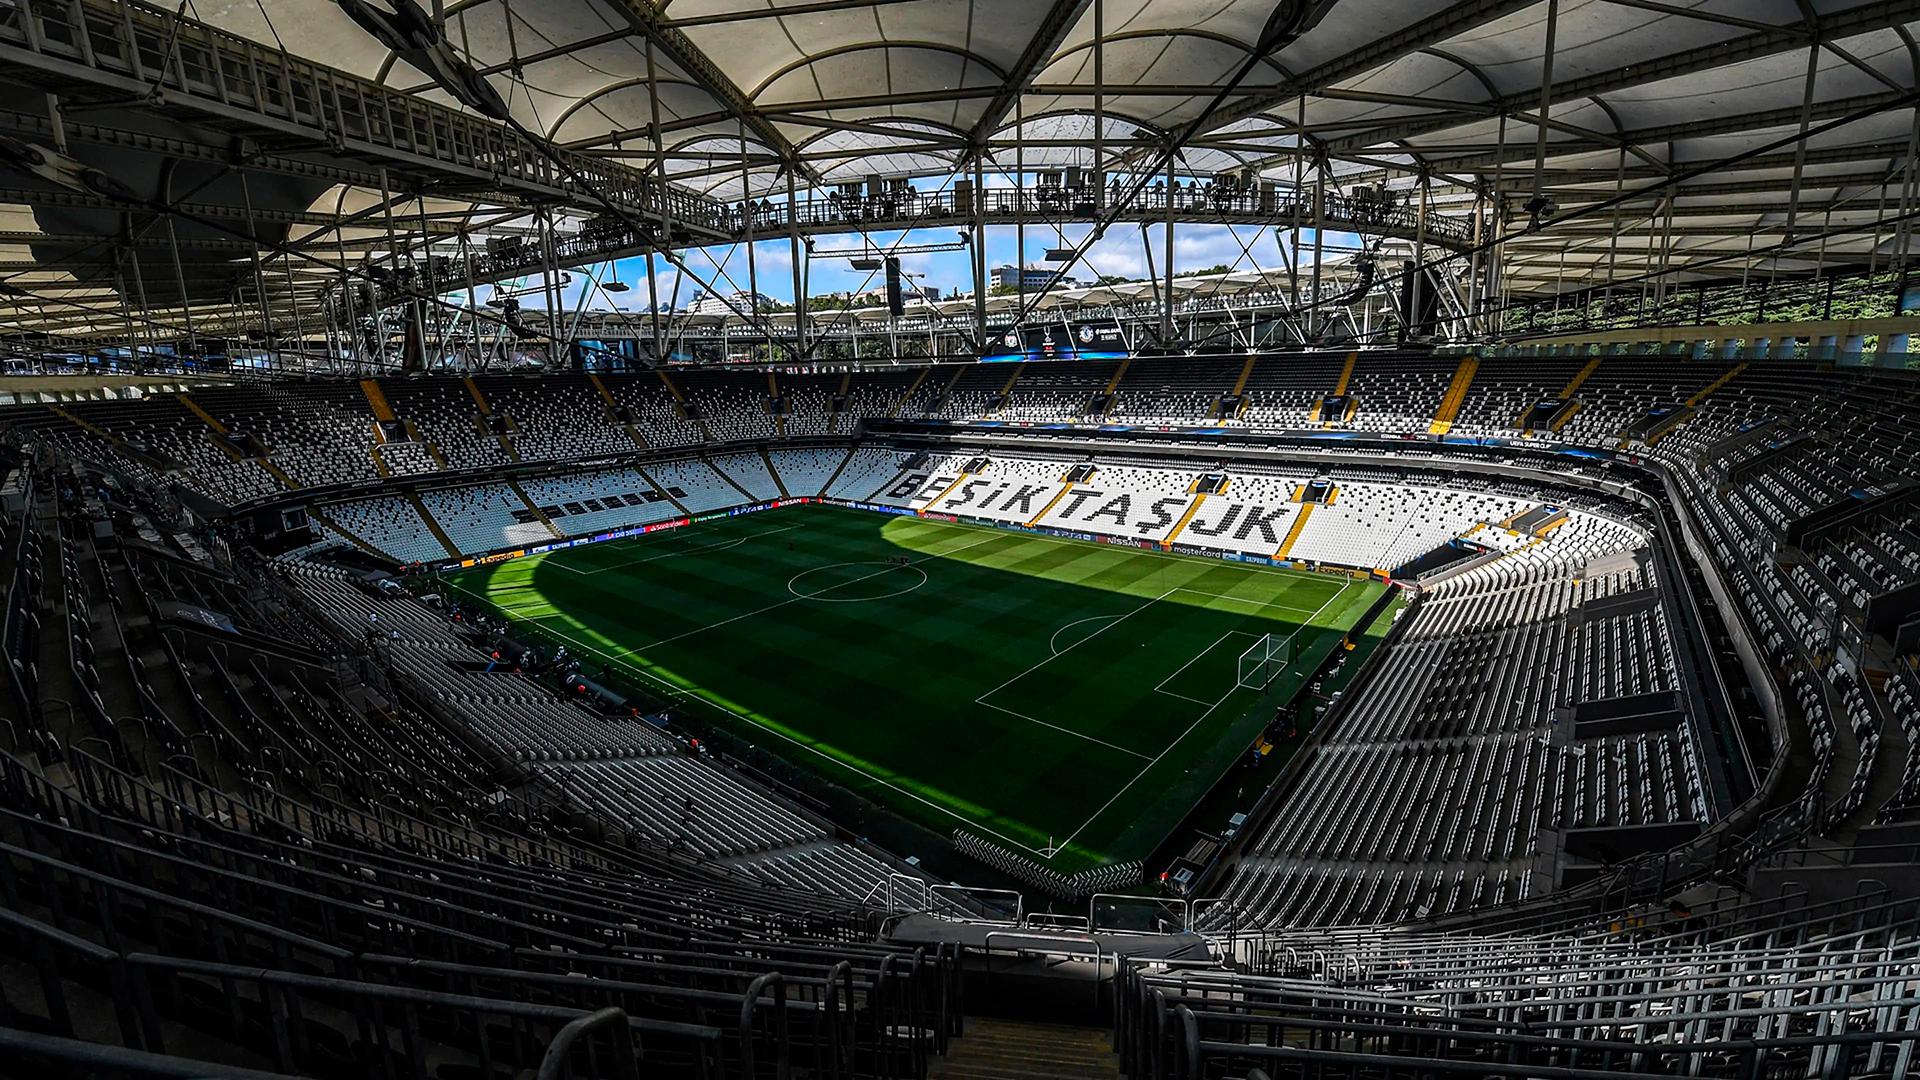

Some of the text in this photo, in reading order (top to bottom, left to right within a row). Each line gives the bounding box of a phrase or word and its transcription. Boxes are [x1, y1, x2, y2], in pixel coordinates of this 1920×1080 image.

[778, 498, 802, 507] NISSAN
[1061, 531, 1082, 540] PS4
[1107, 537, 1142, 548] NISSAN
[1173, 545, 1221, 558] mastercard
[1318, 565, 1355, 578] Expedia
